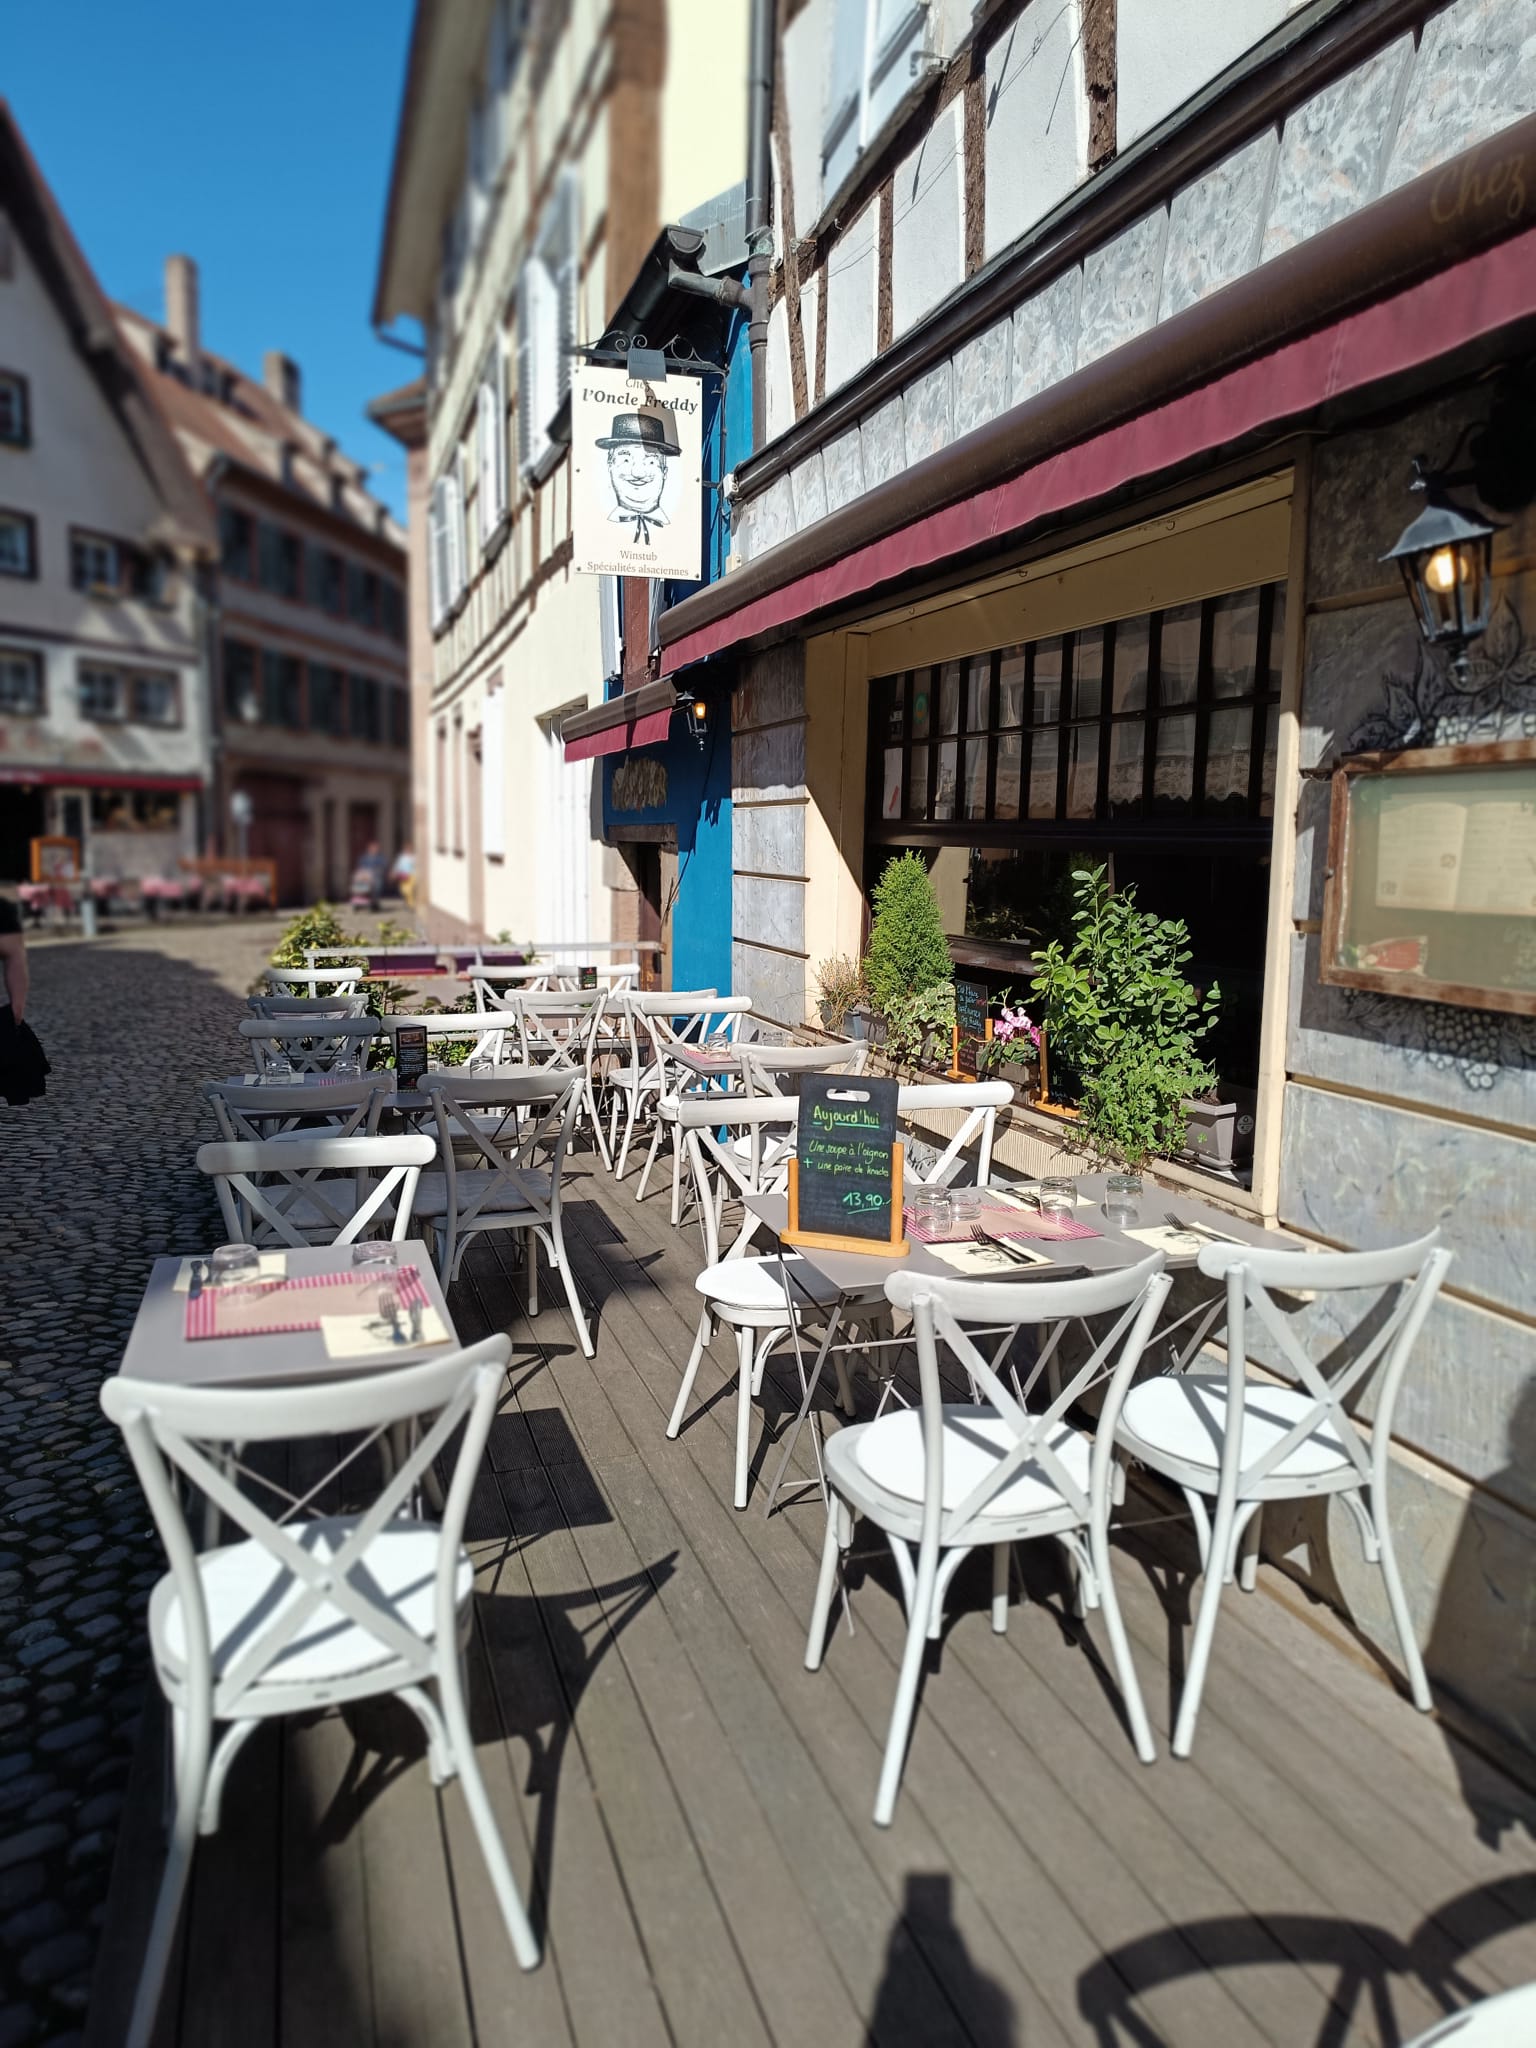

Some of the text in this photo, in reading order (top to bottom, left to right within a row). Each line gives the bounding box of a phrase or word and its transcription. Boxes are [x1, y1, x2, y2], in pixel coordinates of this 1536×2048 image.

[1431, 149, 1527, 224] Chez
[583, 388, 698, 415] l'Oncle Freddy
[620, 550, 658, 561] Winstub
[587, 561, 689, 576] Spécialités alsaciennes
[813, 1105, 880, 1131] Aujourd'hui
[809, 1140, 889, 1165] Une soupe à l'oignon
[818, 1162, 832, 1171] une
[834, 1164, 852, 1175] paire
[854, 1164, 863, 1174] de
